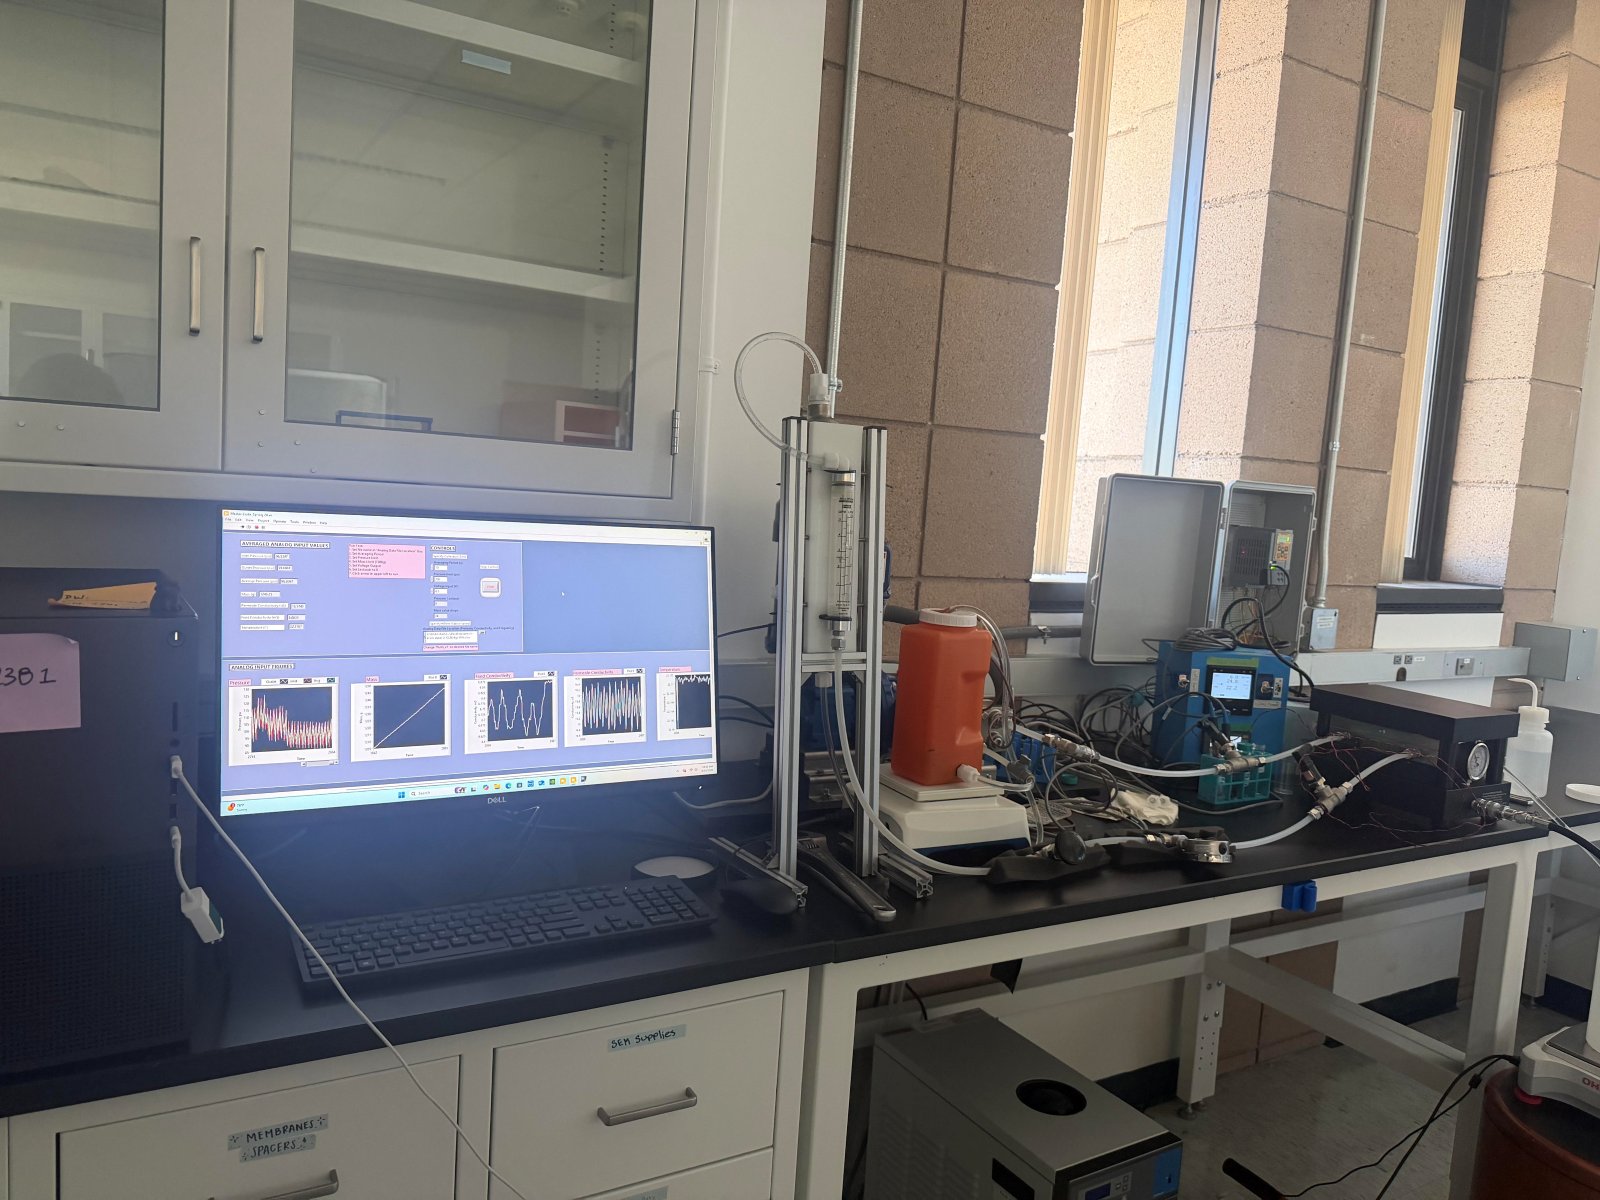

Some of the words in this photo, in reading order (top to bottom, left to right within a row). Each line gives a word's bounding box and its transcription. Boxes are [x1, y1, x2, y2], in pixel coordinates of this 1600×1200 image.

[487, 796, 507, 804] DELL
[611, 1037, 631, 1049] SEM
[635, 1029, 676, 1044] Supplies
[246, 1119, 314, 1143] MEMBRANES
[250, 1139, 296, 1158] SPACERS
